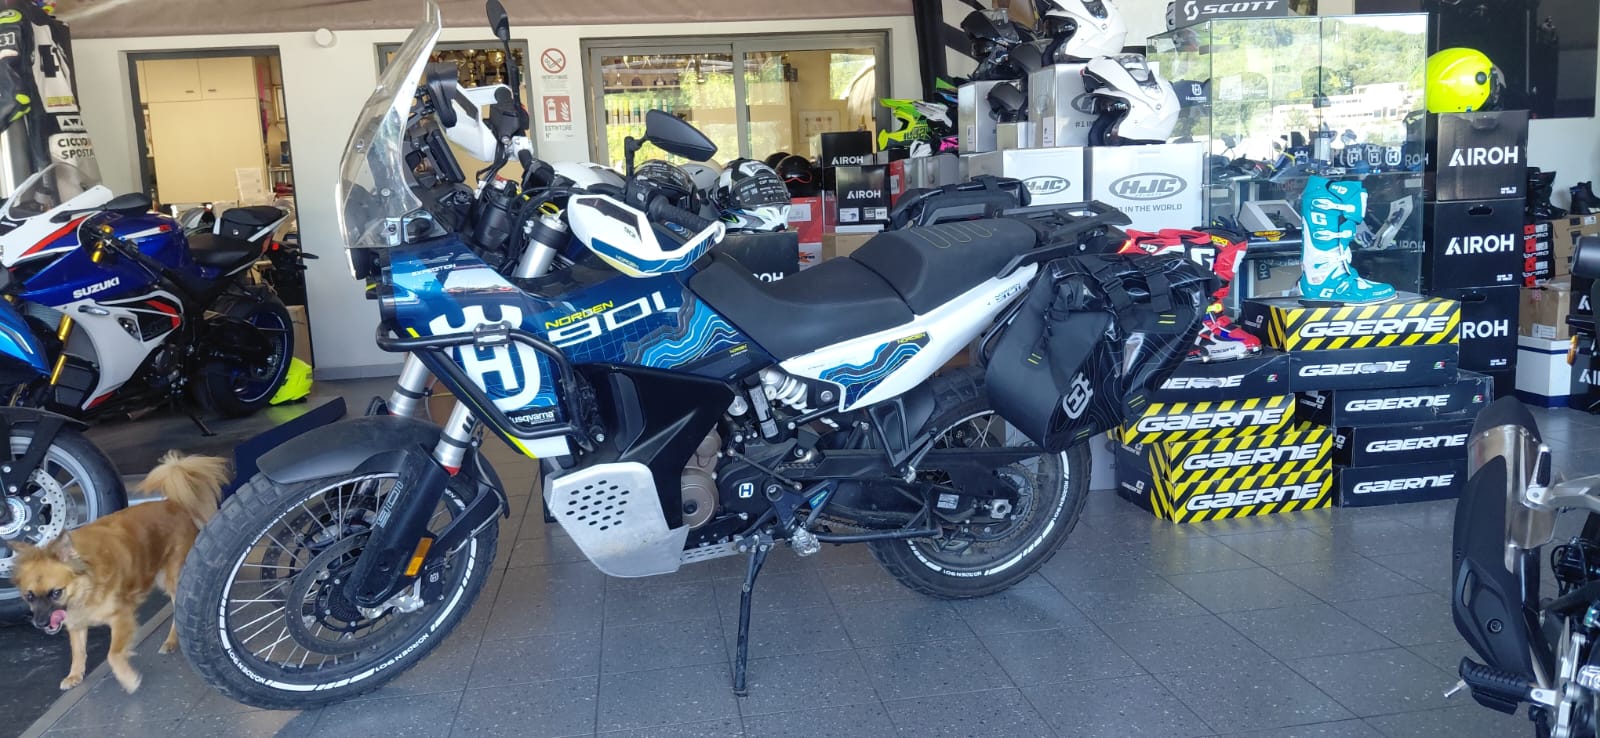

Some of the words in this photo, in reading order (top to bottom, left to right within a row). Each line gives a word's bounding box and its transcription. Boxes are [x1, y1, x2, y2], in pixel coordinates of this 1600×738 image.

[1201, 1, 1279, 14] SCOTT
[831, 156, 864, 166] AIROH
[1448, 145, 1519, 167] AIROH
[847, 190, 881, 199] AIROH
[1119, 178, 1178, 195] HJC
[1125, 204, 1134, 213] IN
[1135, 203, 1151, 213] THE
[1156, 202, 1183, 212] WORLD
[1444, 233, 1515, 256] AIROH
[73, 277, 120, 299] SUZUKI
[545, 300, 614, 330] NORDEN
[548, 291, 666, 348] 901
[897, 331, 927, 344] NORDEN
[1300, 316, 1450, 338] GAERNE
[1344, 394, 1450, 412] GAERNE
[1136, 408, 1285, 433] GAERNE
[1365, 433, 1469, 453] GAERNE
[1183, 442, 1322, 471] GAERNE
[1353, 473, 1455, 494] GAERNE
[1186, 482, 1323, 512] GAERNE
